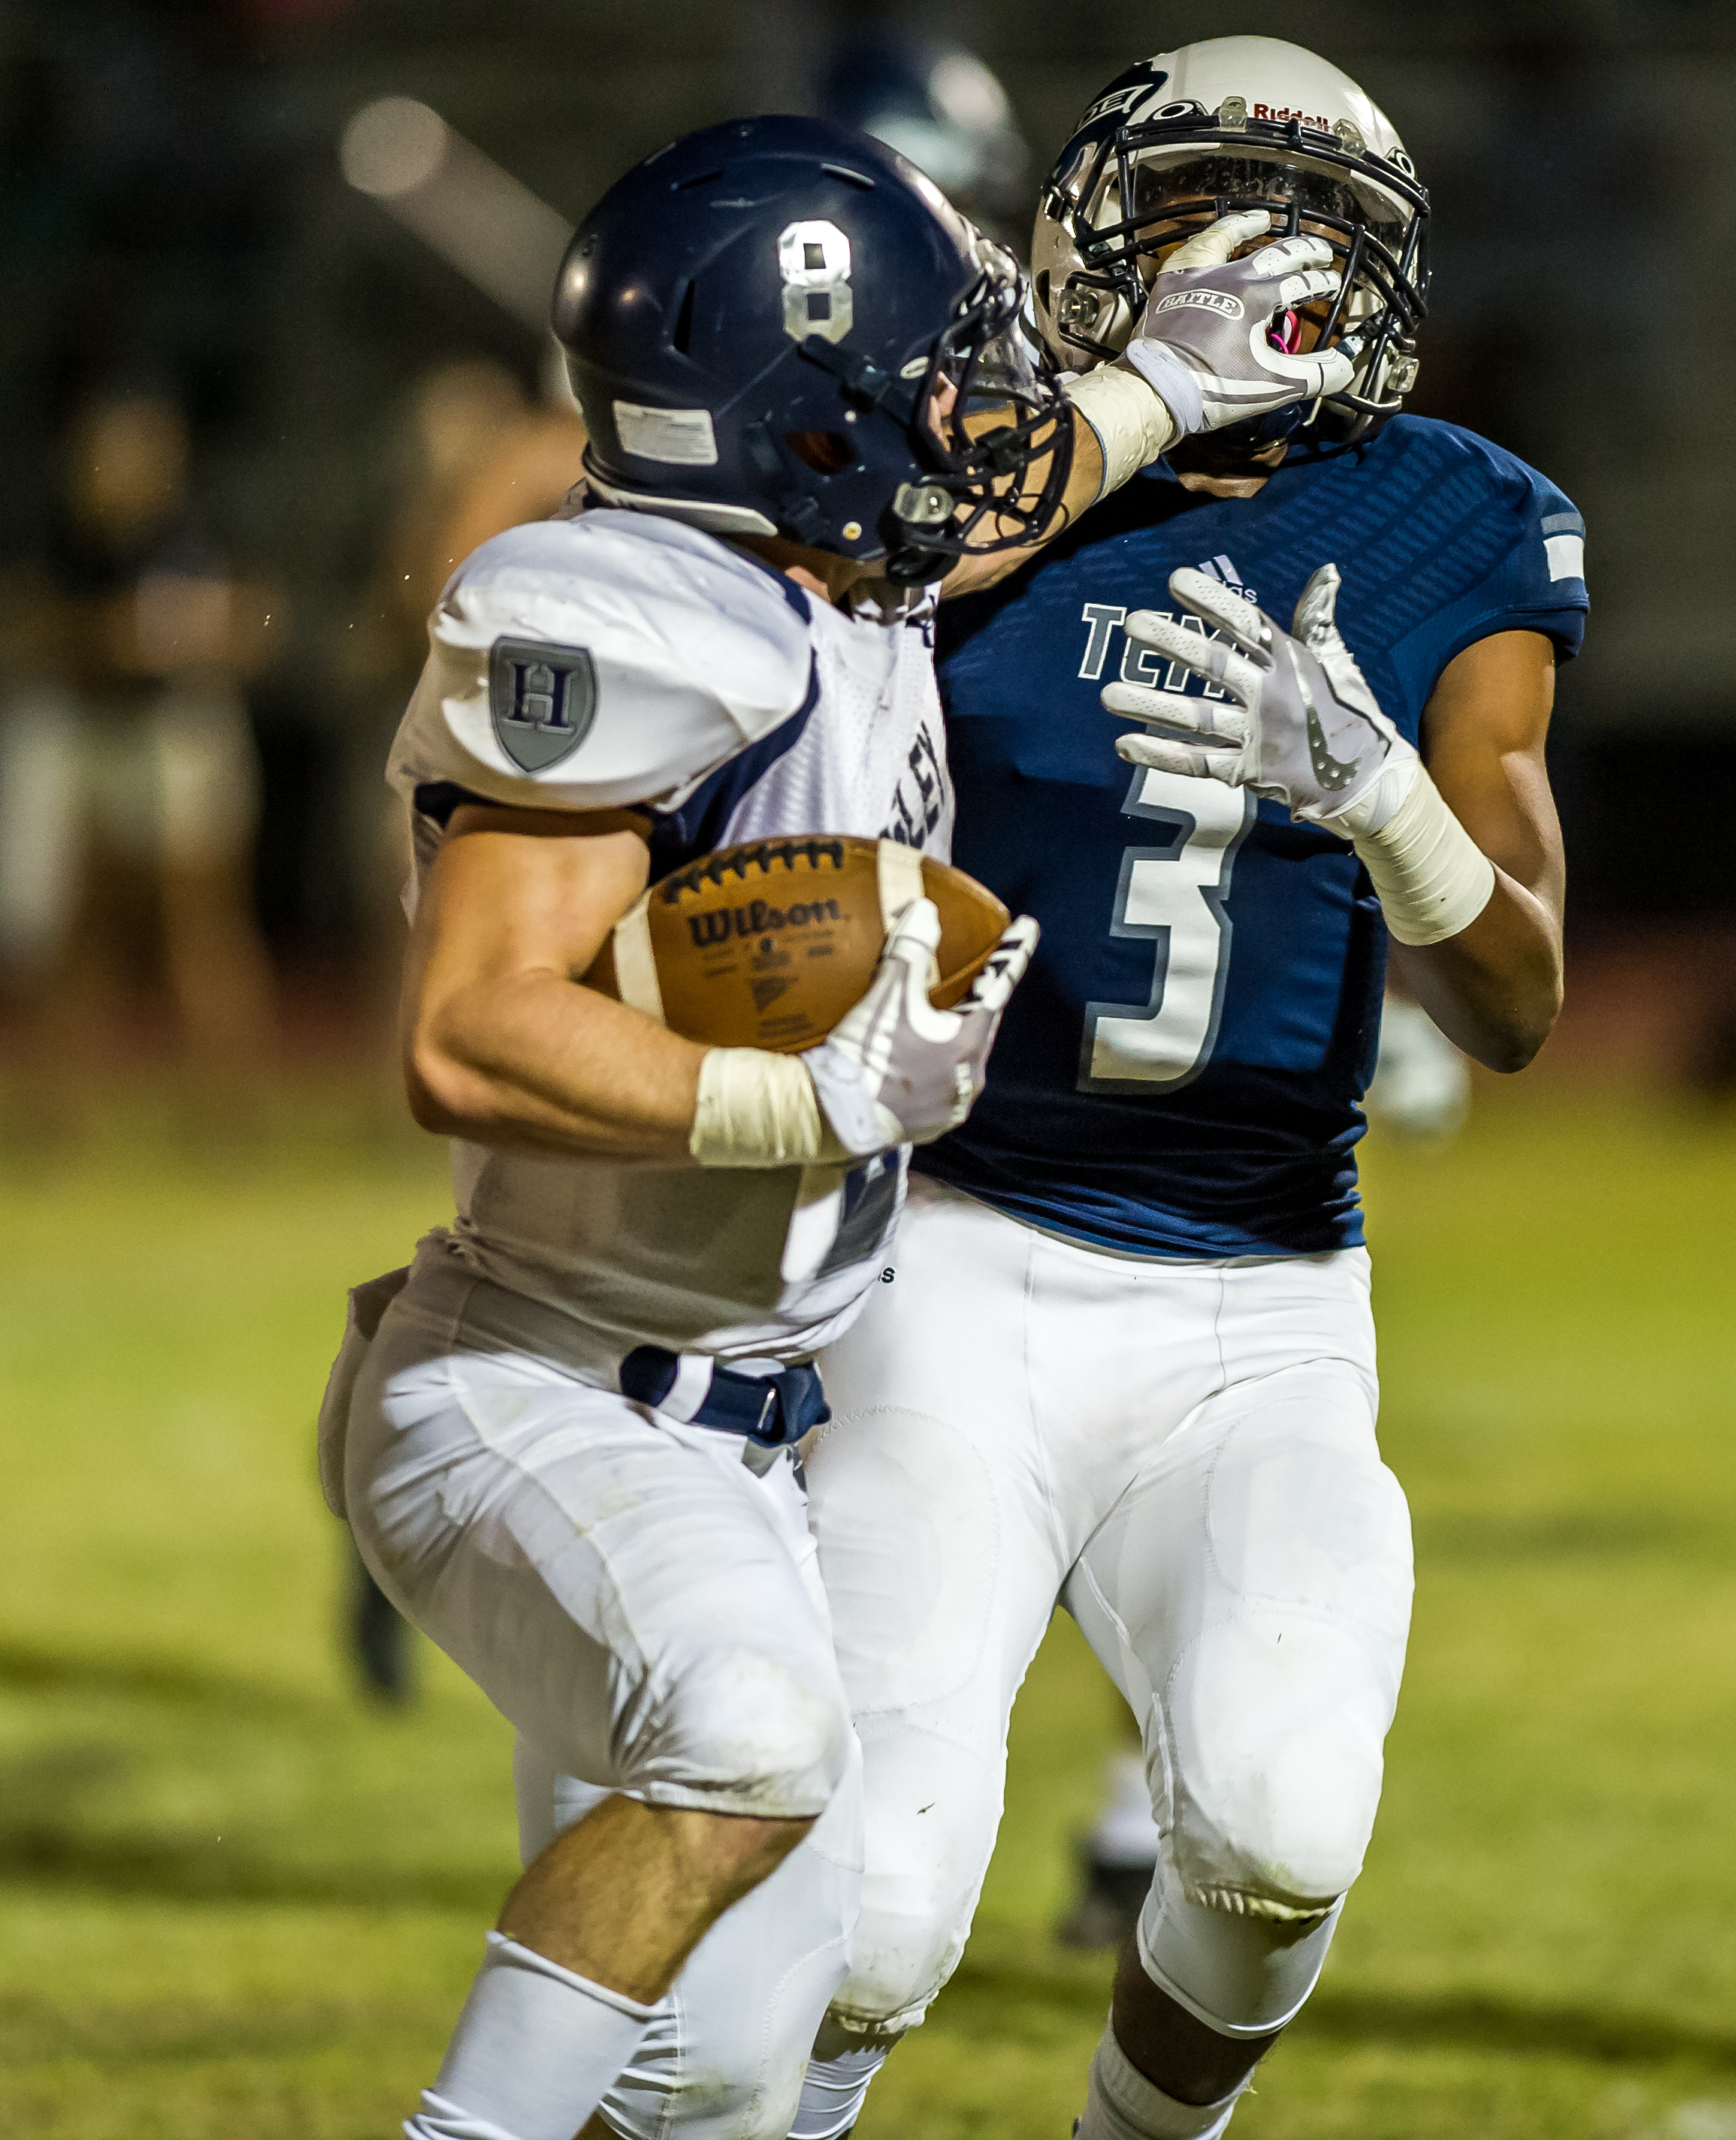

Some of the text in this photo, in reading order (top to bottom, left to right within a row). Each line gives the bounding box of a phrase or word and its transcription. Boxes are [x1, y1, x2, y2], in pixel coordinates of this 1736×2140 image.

[1253, 103, 1329, 132] Riddell
[777, 220, 854, 345] 8
[1161, 292, 1237, 315] BATTLE
[503, 659, 581, 735] H
[686, 898, 839, 947] Wilson
[1076, 723, 1259, 1096] 3
